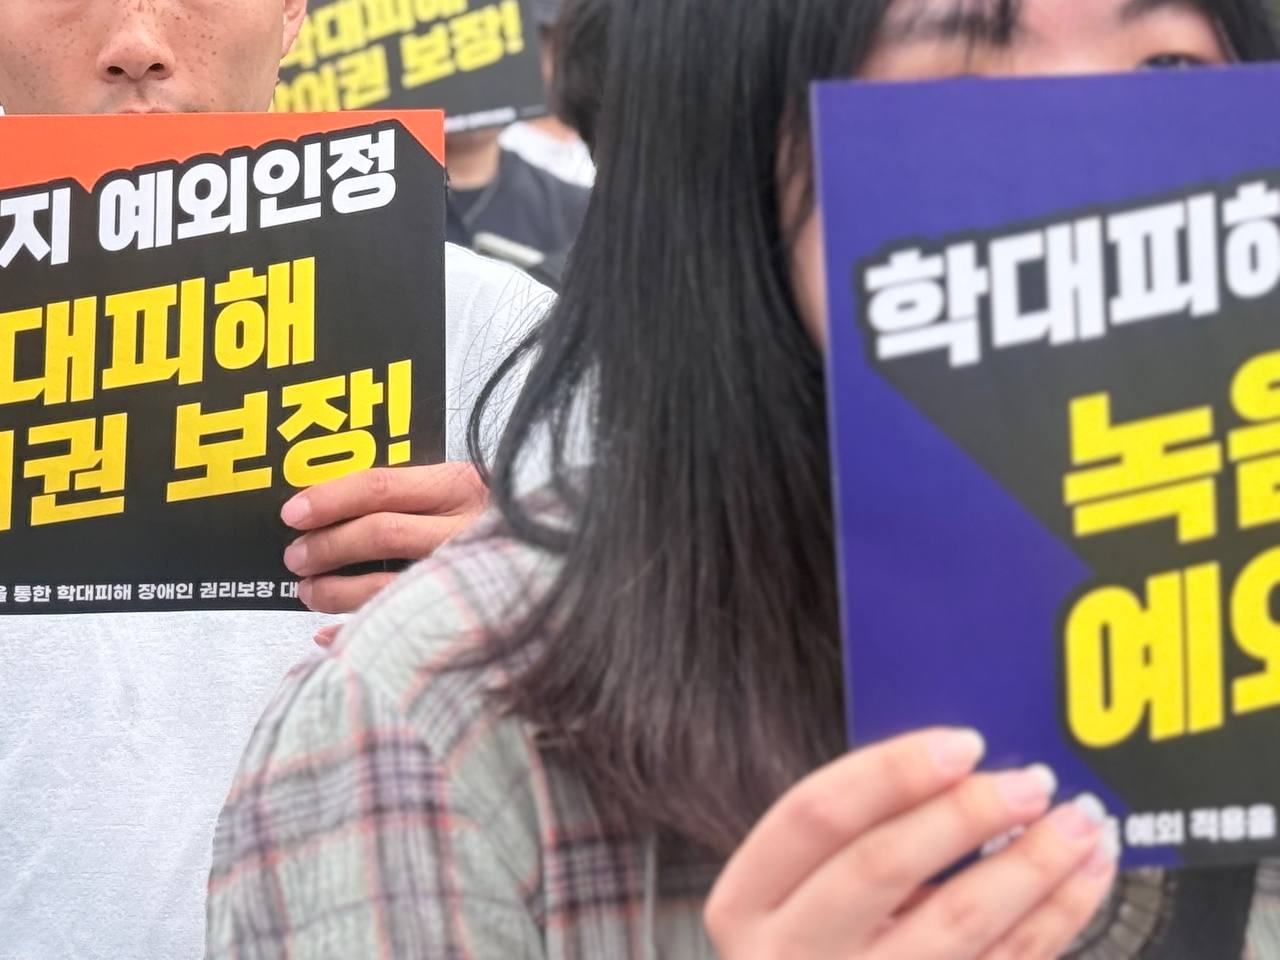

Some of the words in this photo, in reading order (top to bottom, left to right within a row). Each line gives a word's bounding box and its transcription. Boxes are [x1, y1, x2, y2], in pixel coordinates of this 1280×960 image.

[98, 128, 397, 252] 예외인정
[166, 359, 412, 502] 보장!
[13, 584, 52, 603] 통한
[57, 583, 132, 602] 학대피해
[138, 582, 194, 601] 장애인
[200, 581, 275, 600] 권리보장
[1124, 807, 1185, 846] 예외
